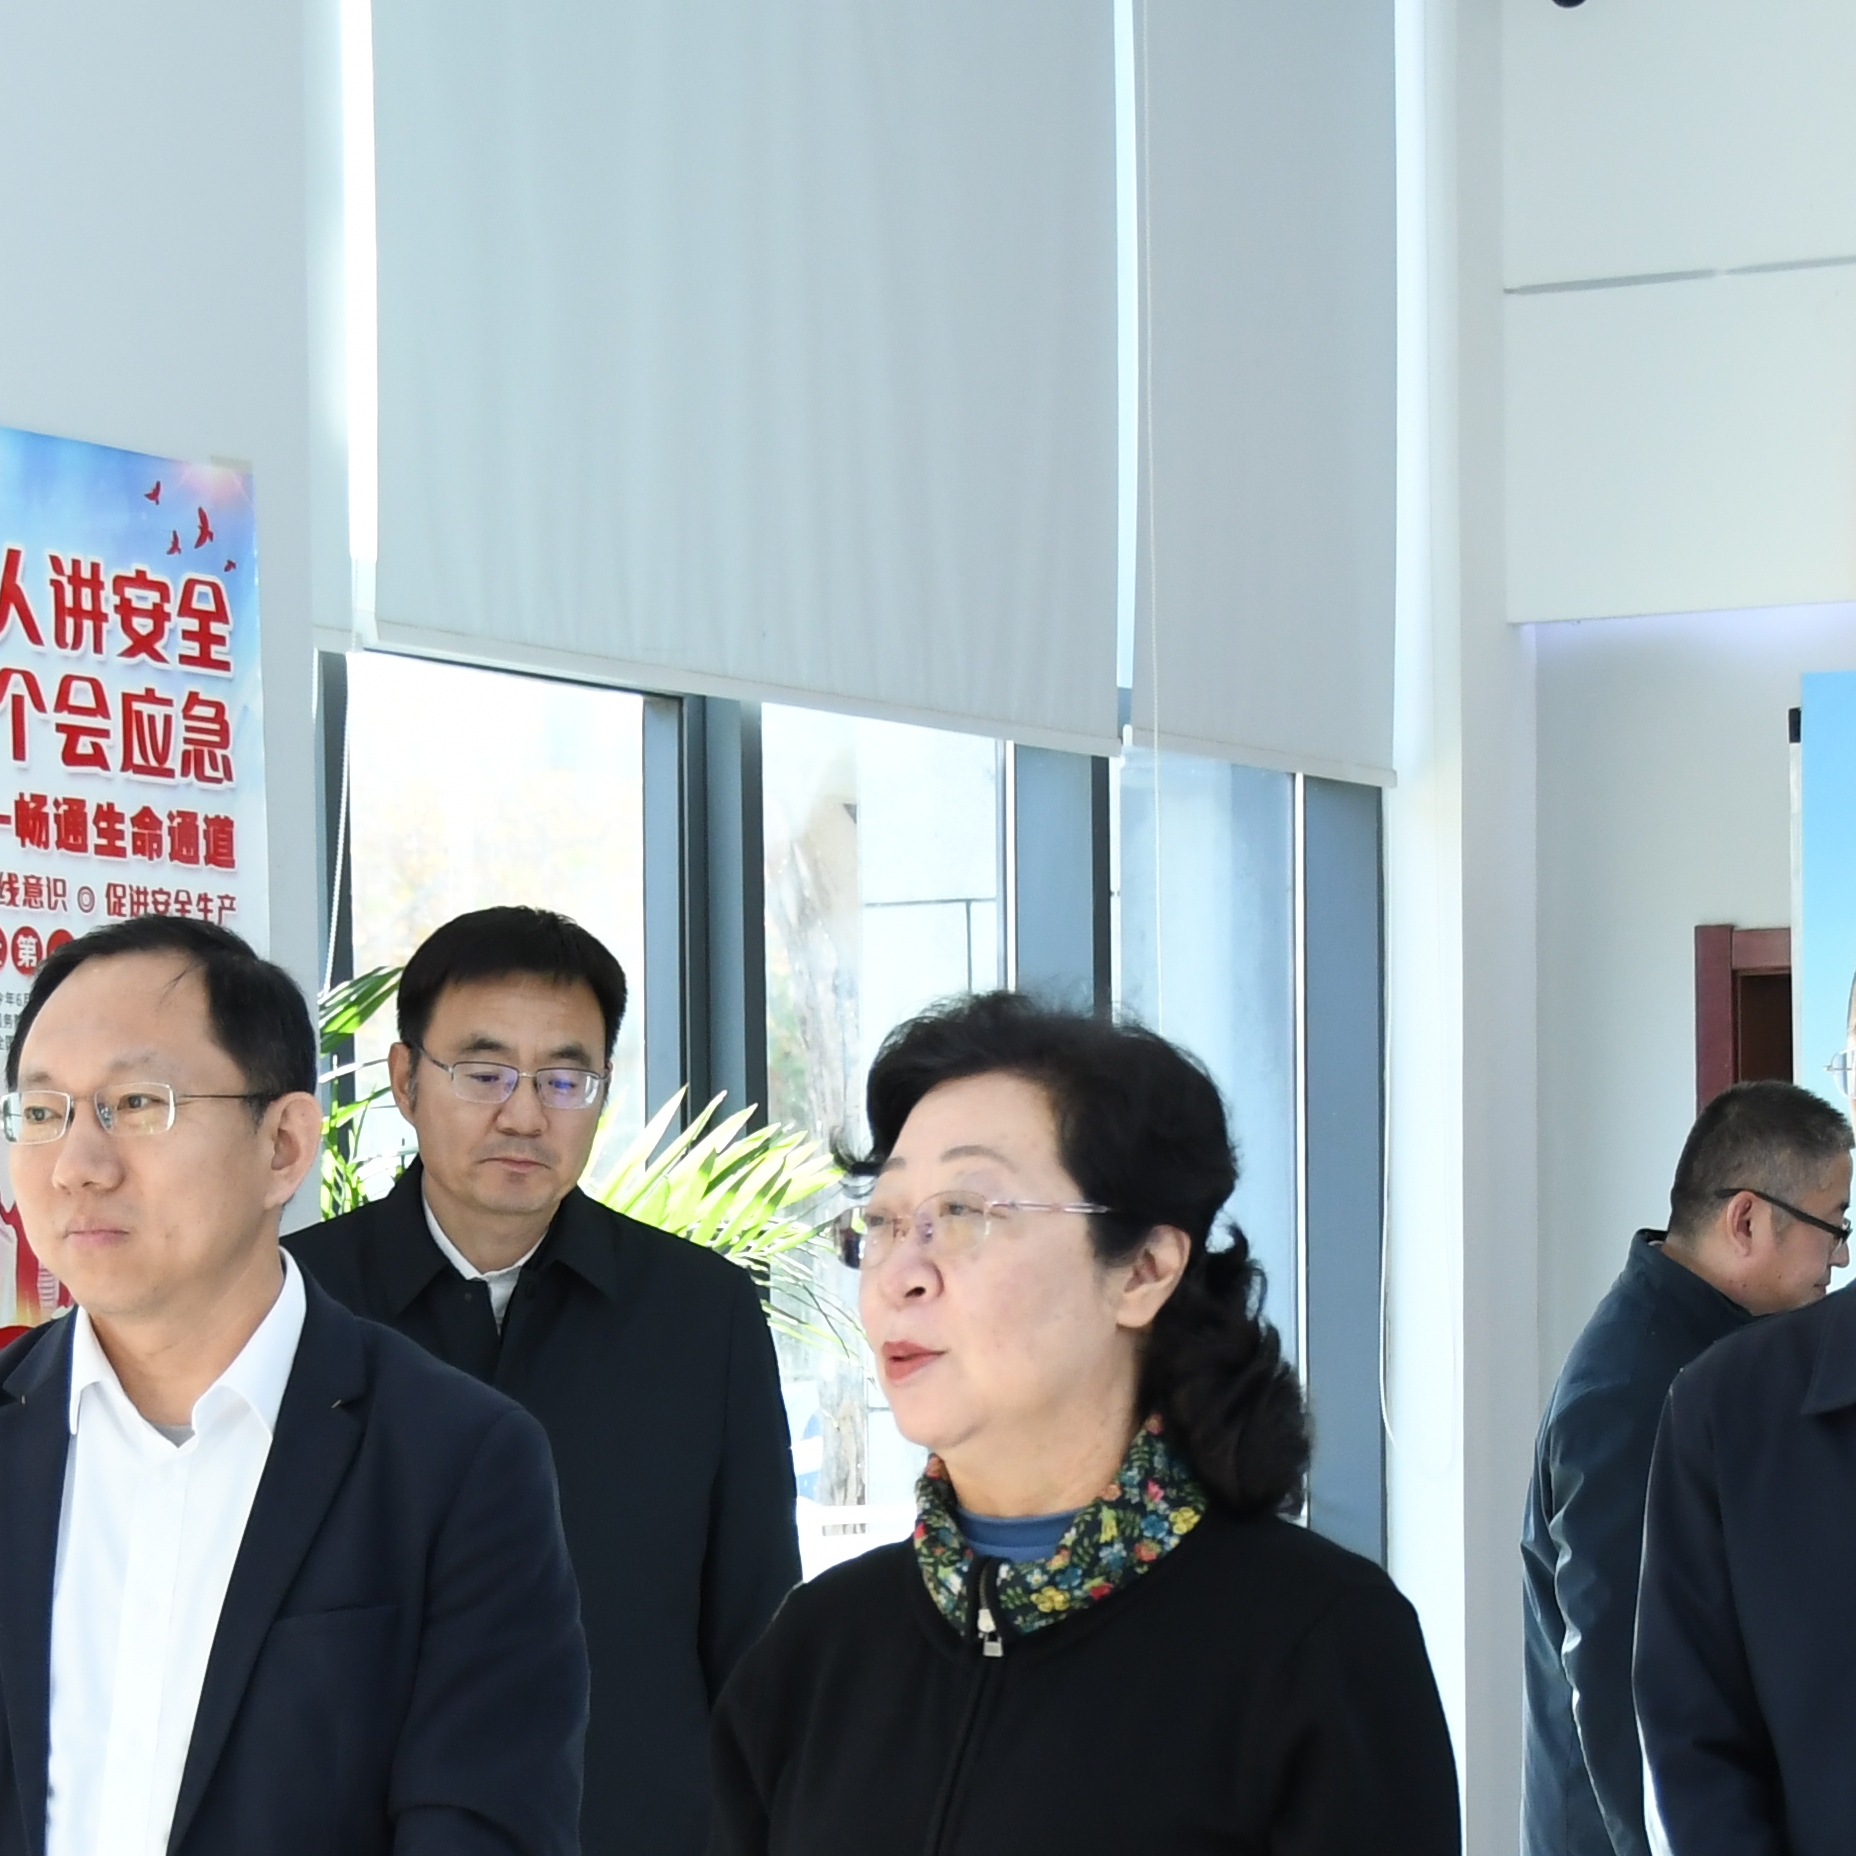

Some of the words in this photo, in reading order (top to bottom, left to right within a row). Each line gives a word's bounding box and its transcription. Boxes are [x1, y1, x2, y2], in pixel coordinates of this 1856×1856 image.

[105, 882, 237, 925] 促进安全生产
